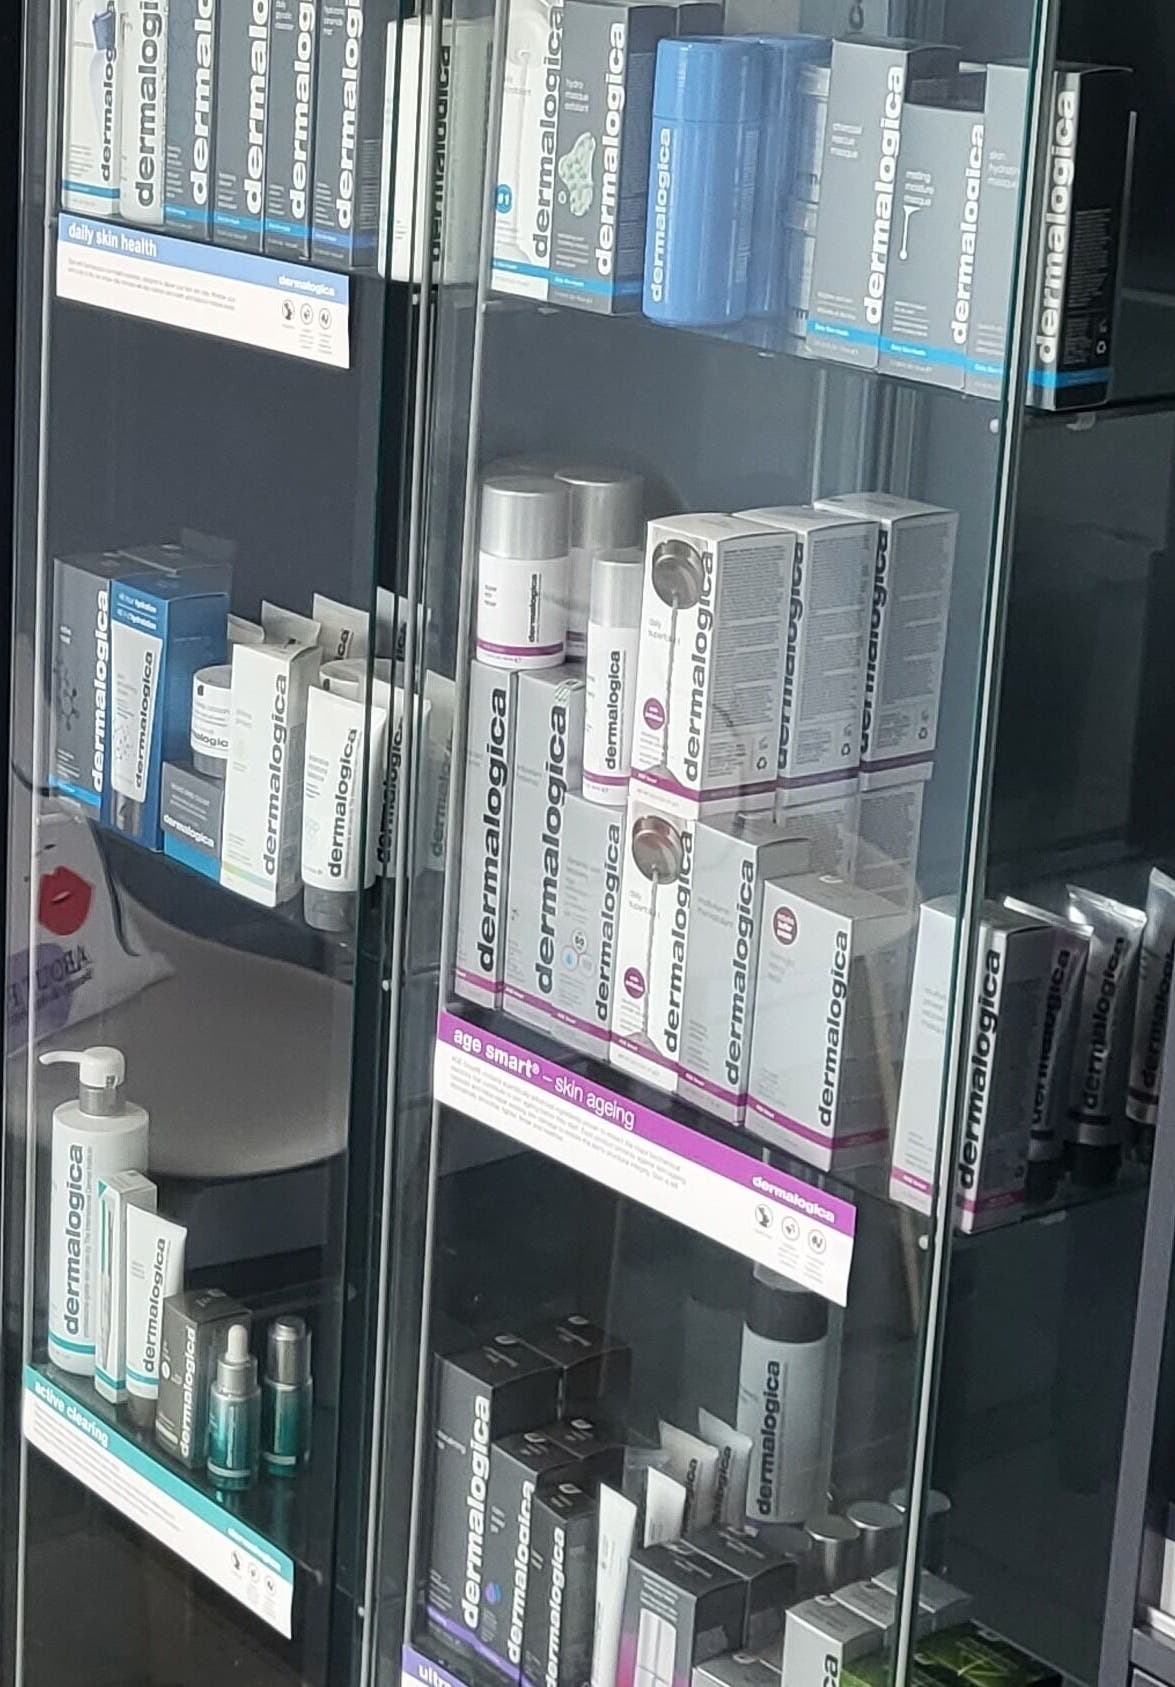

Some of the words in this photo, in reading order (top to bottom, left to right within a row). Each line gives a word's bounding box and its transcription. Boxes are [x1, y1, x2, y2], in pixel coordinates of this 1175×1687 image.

[135, 0, 163, 207] dermalogi
[190, 0, 213, 205] dermalo
[244, 0, 268, 214] dermalo
[290, 0, 314, 219] dermalog
[336, 0, 363, 229] dermalogi
[533, 6, 564, 258] dermalogica
[595, 22, 626, 275] dermalogica
[863, 65, 905, 325] dermalogica
[68, 222, 94, 245] daily
[95, 229, 119, 249] skin
[121, 234, 158, 258] health
[651, 128, 671, 303] dermalogica
[950, 123, 985, 345] dermalogica
[1035, 89, 1076, 365] dermalogica
[91, 589, 110, 793] dermalogica
[135, 650, 154, 789] dermalogica
[605, 650, 621, 770] dermalogica
[685, 551, 714, 783] dermalogica
[164, 813, 215, 849] dermalogica
[264, 673, 287, 876] dermalogica
[328, 728, 358, 878] dermalogica
[477, 687, 508, 973] dermalogica
[535, 703, 568, 994] dermalogica
[595, 823, 621, 1022] dermalogica
[664, 830, 693, 1053] dermalogica
[725, 859, 755, 1085] dermalogica
[453, 1028, 482, 1054] age
[555, 1075, 584, 1103] skin
[586, 1093, 635, 1132] ageing
[818, 929, 848, 1127] dermalogica
[957, 949, 1000, 1190] dermalogica
[63, 1144, 85, 1336] dermalogica
[752, 1176, 836, 1224] dermalogica
[143, 1237, 166, 1373] dermalogica
[179, 1326, 197, 1458] dermalogica
[33, 1379, 65, 1416] active
[65, 1405, 110, 1449] clearing
[462, 1395, 490, 1630] dermalogica
[758, 1360, 781, 1516] dermalogica
[508, 1479, 536, 1665] dermalogica
